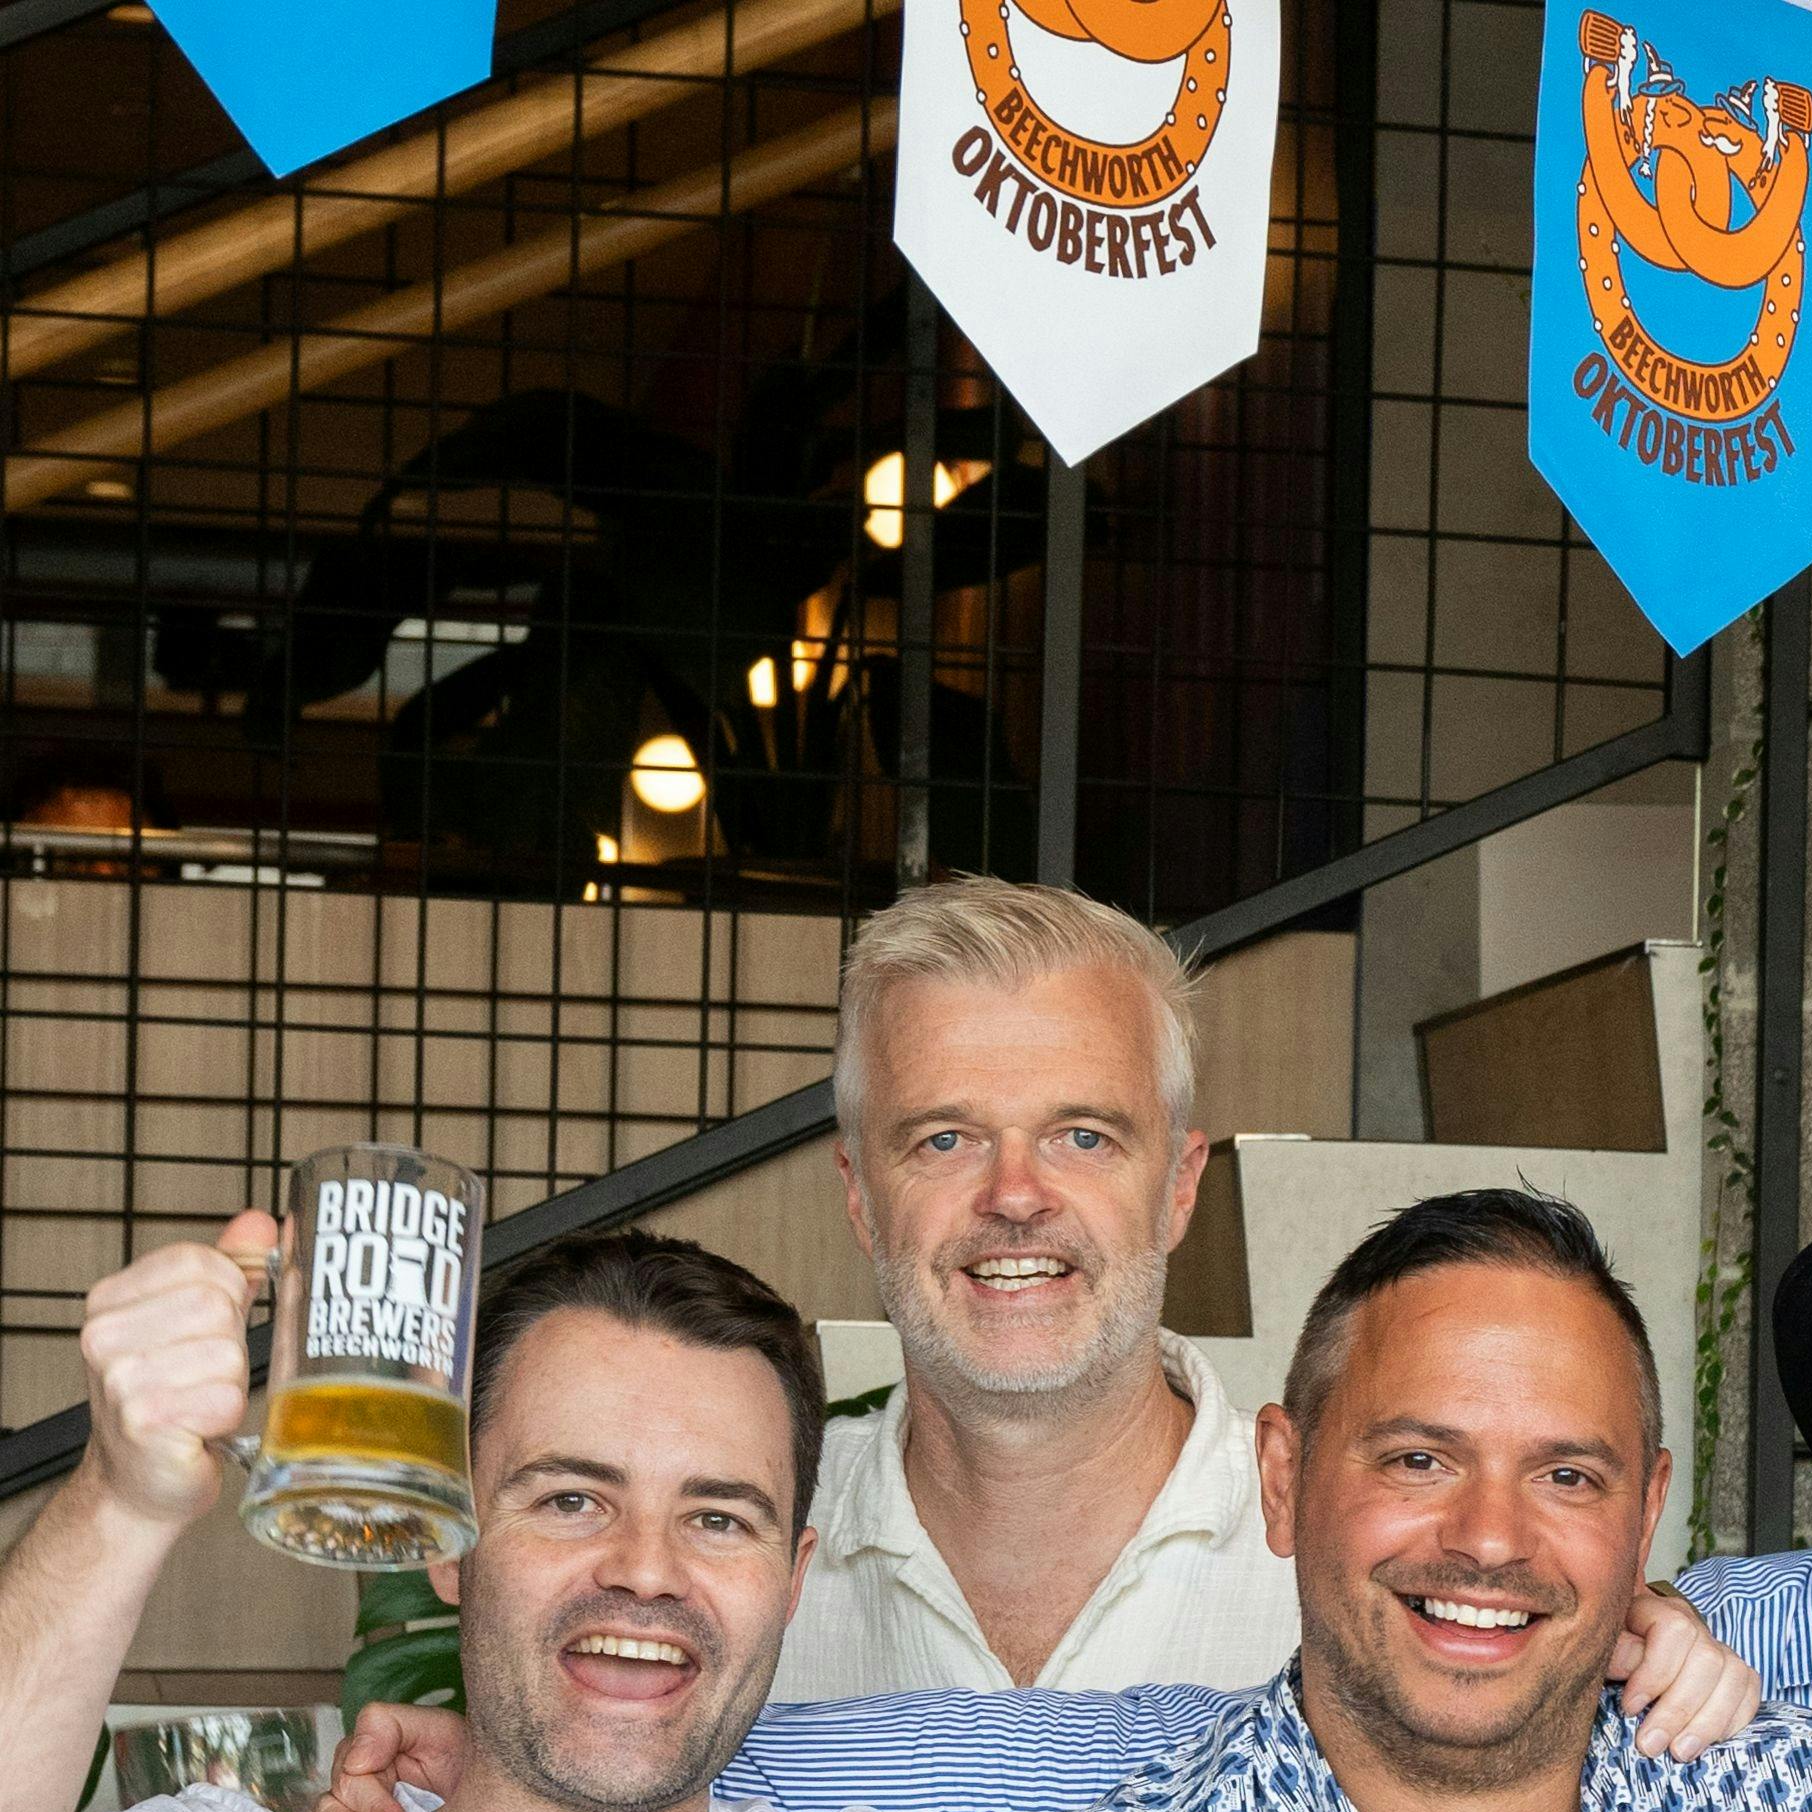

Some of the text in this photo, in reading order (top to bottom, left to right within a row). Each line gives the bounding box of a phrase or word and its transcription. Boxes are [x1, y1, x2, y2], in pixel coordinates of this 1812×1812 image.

[992, 86, 1185, 199] BEECHWORTH
[951, 125, 1217, 279] OKTOBERFEST
[1610, 315, 1768, 414] BEECHWORTH
[1573, 351, 1796, 487] OKTOBERFEST
[316, 1178, 467, 1257] BRIDGE
[311, 1231, 462, 1321] ROAD
[306, 1333, 454, 1378] BEECHWORTH
[307, 1296, 457, 1356] BREWERS
